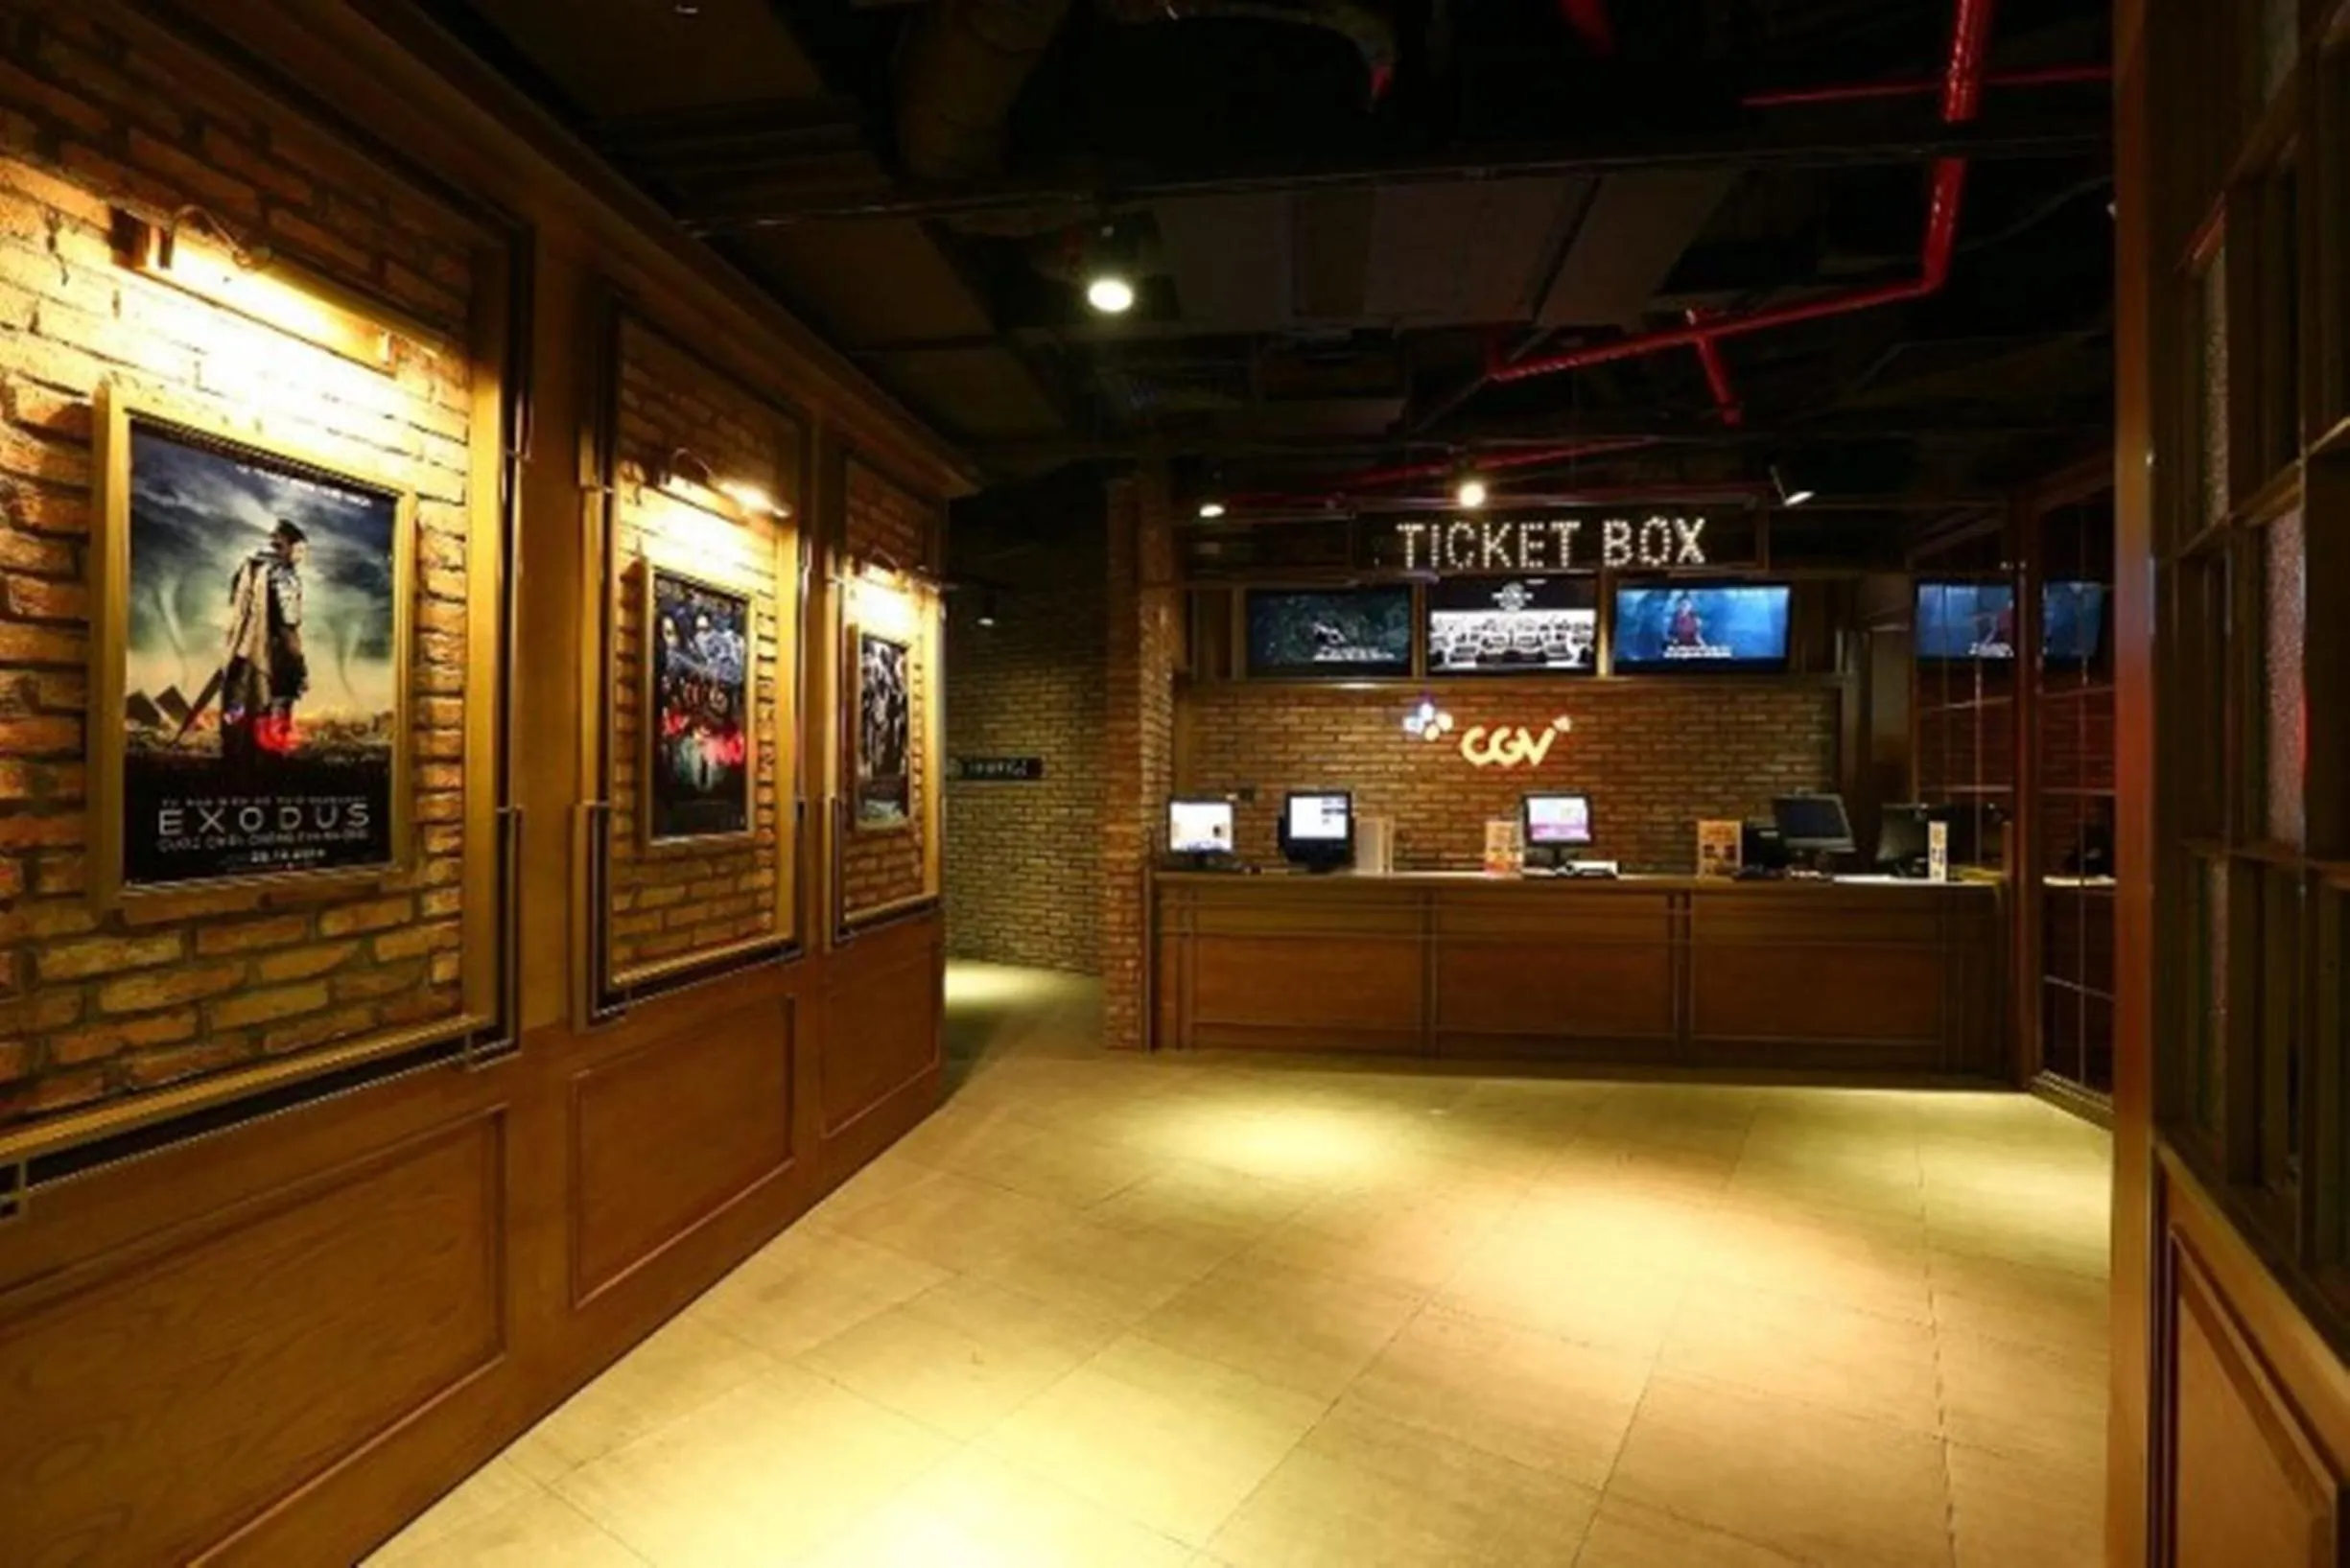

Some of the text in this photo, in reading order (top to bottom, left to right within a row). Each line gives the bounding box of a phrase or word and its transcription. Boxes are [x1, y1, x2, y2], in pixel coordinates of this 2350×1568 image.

[1396, 516, 1706, 571] TICKET BOX
[1460, 724, 1559, 767] CGV
[157, 802, 370, 836] EXODUS
